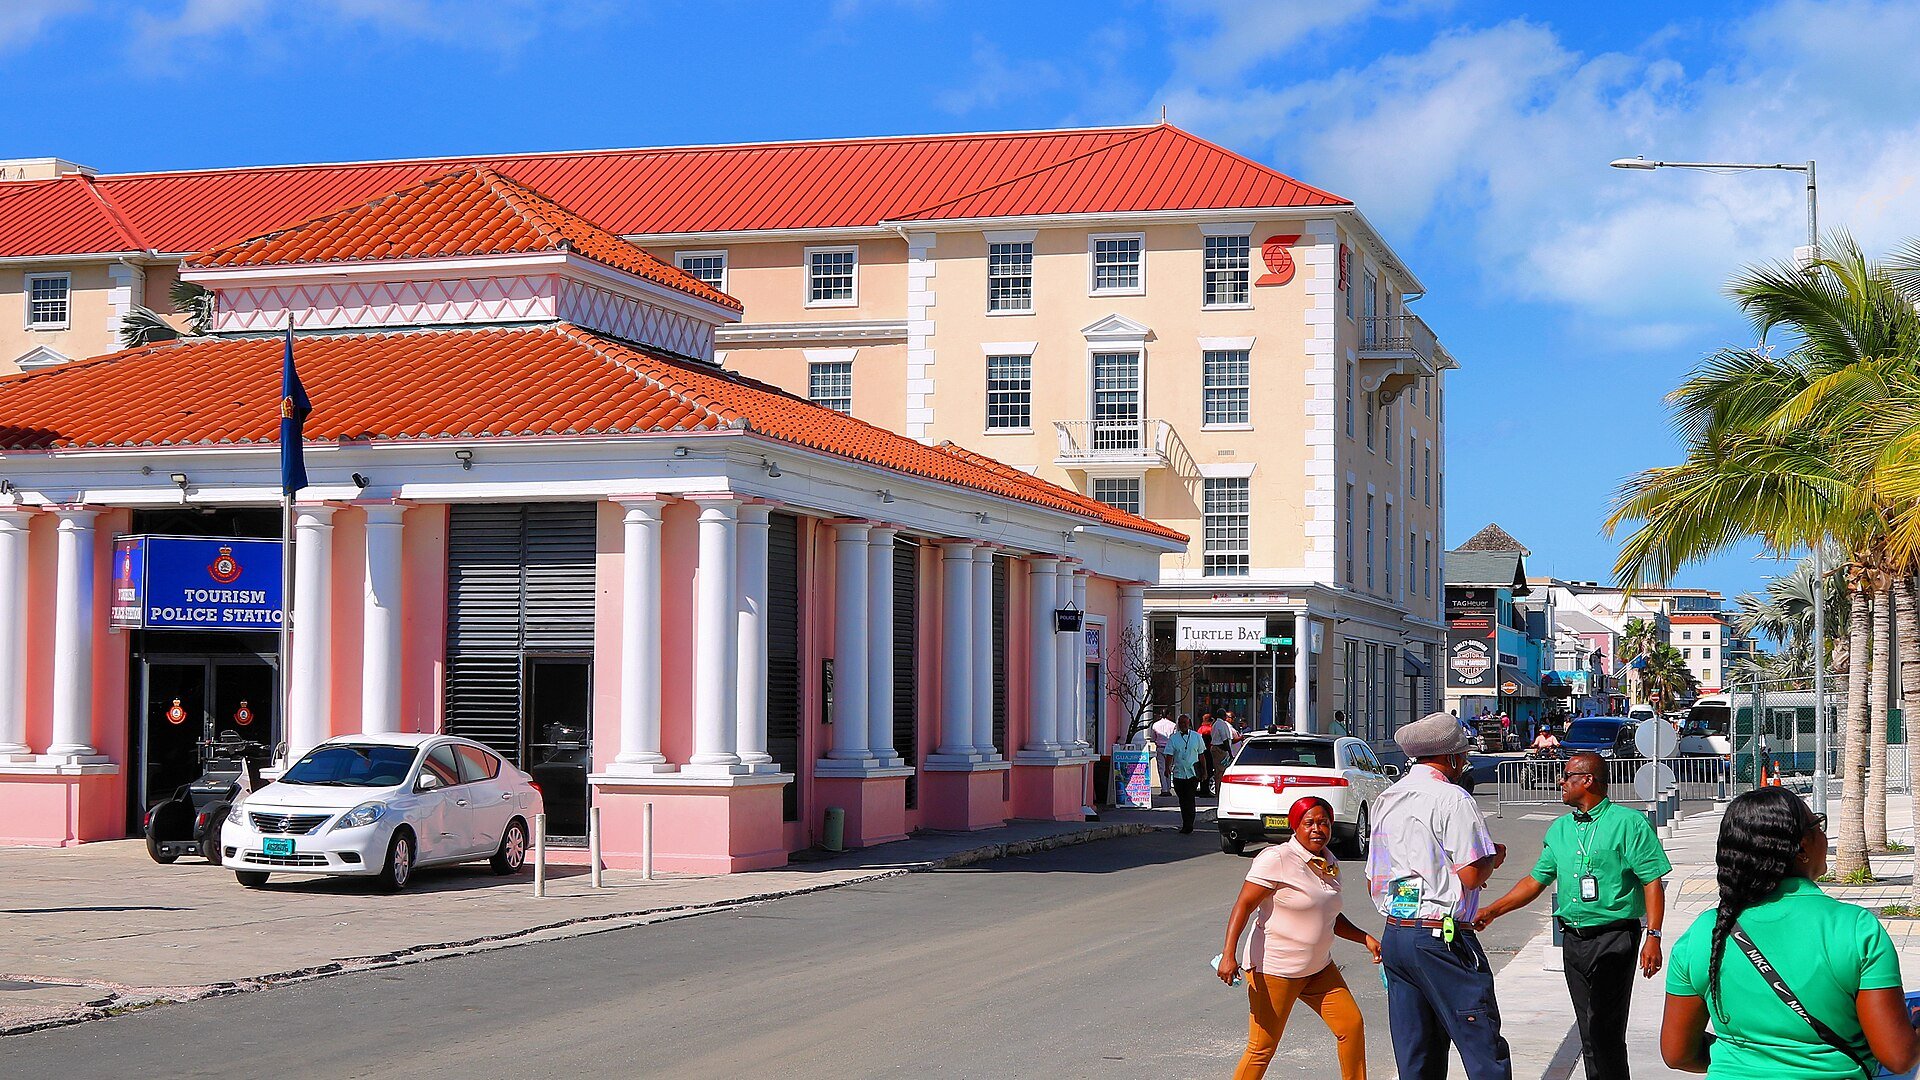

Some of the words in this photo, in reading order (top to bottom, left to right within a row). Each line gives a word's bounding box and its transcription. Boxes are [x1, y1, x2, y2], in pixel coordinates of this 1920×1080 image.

[184, 589, 266, 604] TOURISM
[151, 607, 218, 622] POLICE
[1747, 949, 1773, 974] NIKE
